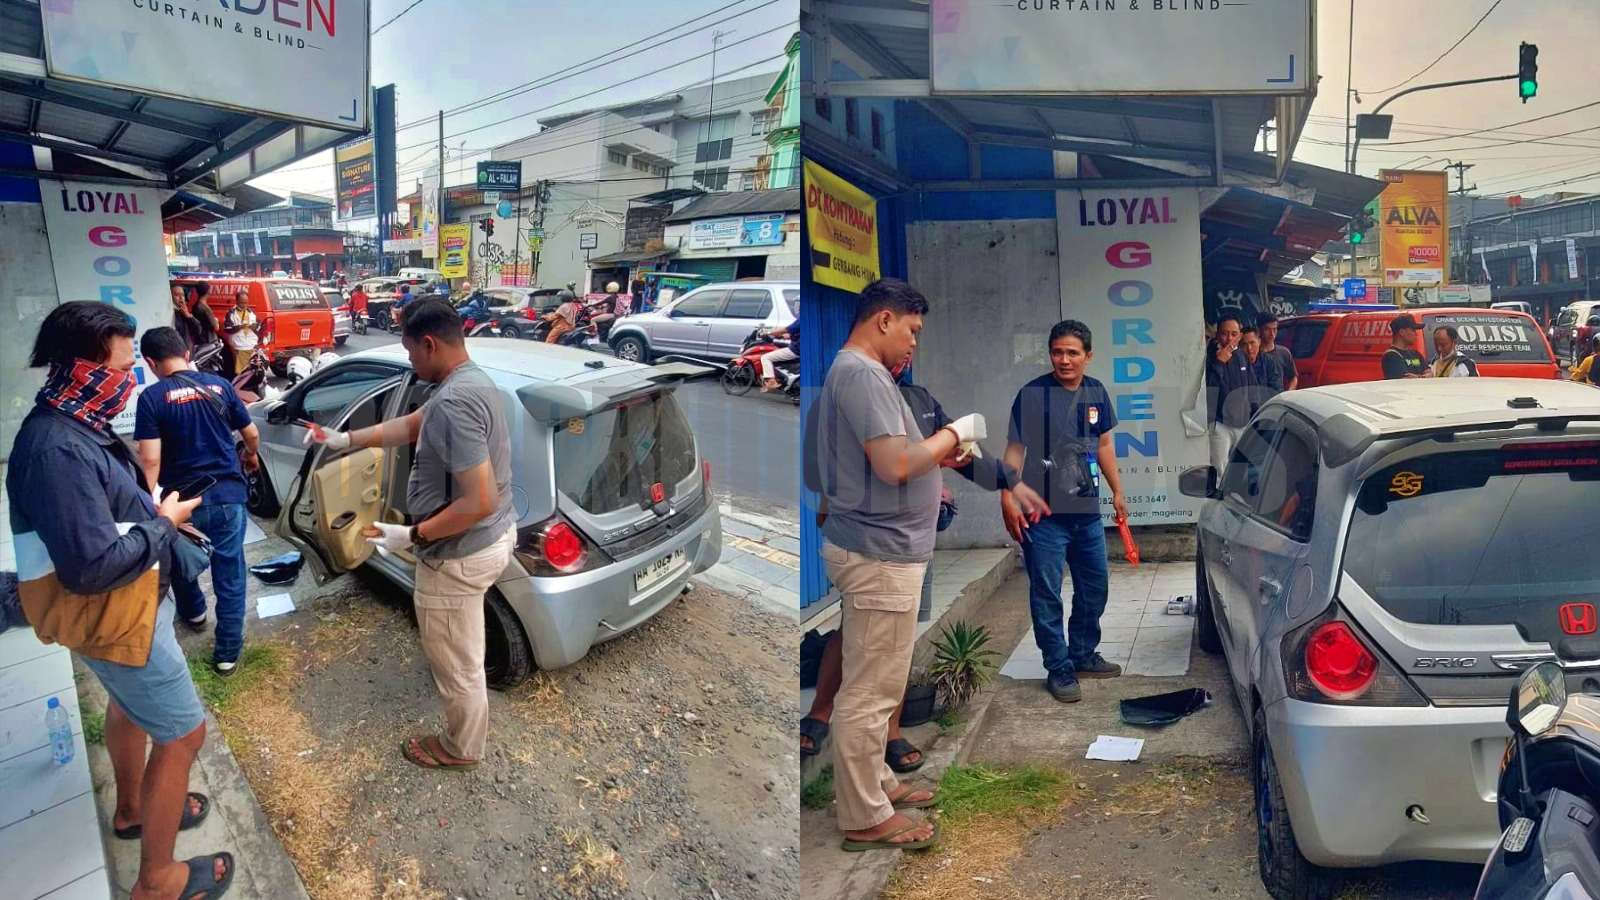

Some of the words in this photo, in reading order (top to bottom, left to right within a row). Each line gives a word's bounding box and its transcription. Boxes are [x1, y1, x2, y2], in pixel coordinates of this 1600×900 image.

[1017, 0, 1115, 11] CURTAIN
[1129, 0, 1139, 10] &
[1153, 0, 1220, 11] BLIND
[133, 0, 224, 29] CURTAIN
[234, 22, 243, 33] &
[254, 27, 305, 49] BLIND
[61, 189, 145, 215] LOYAL
[1079, 196, 1177, 226] LOYAL
[1386, 206, 1440, 225] ALVA
[275, 287, 318, 300] POLISI
[1457, 325, 1529, 342] OLISI
[1105, 241, 1159, 458] GORDEN
[1157, 465, 1192, 473] BLIN
[1412, 656, 1479, 669] BRIO
